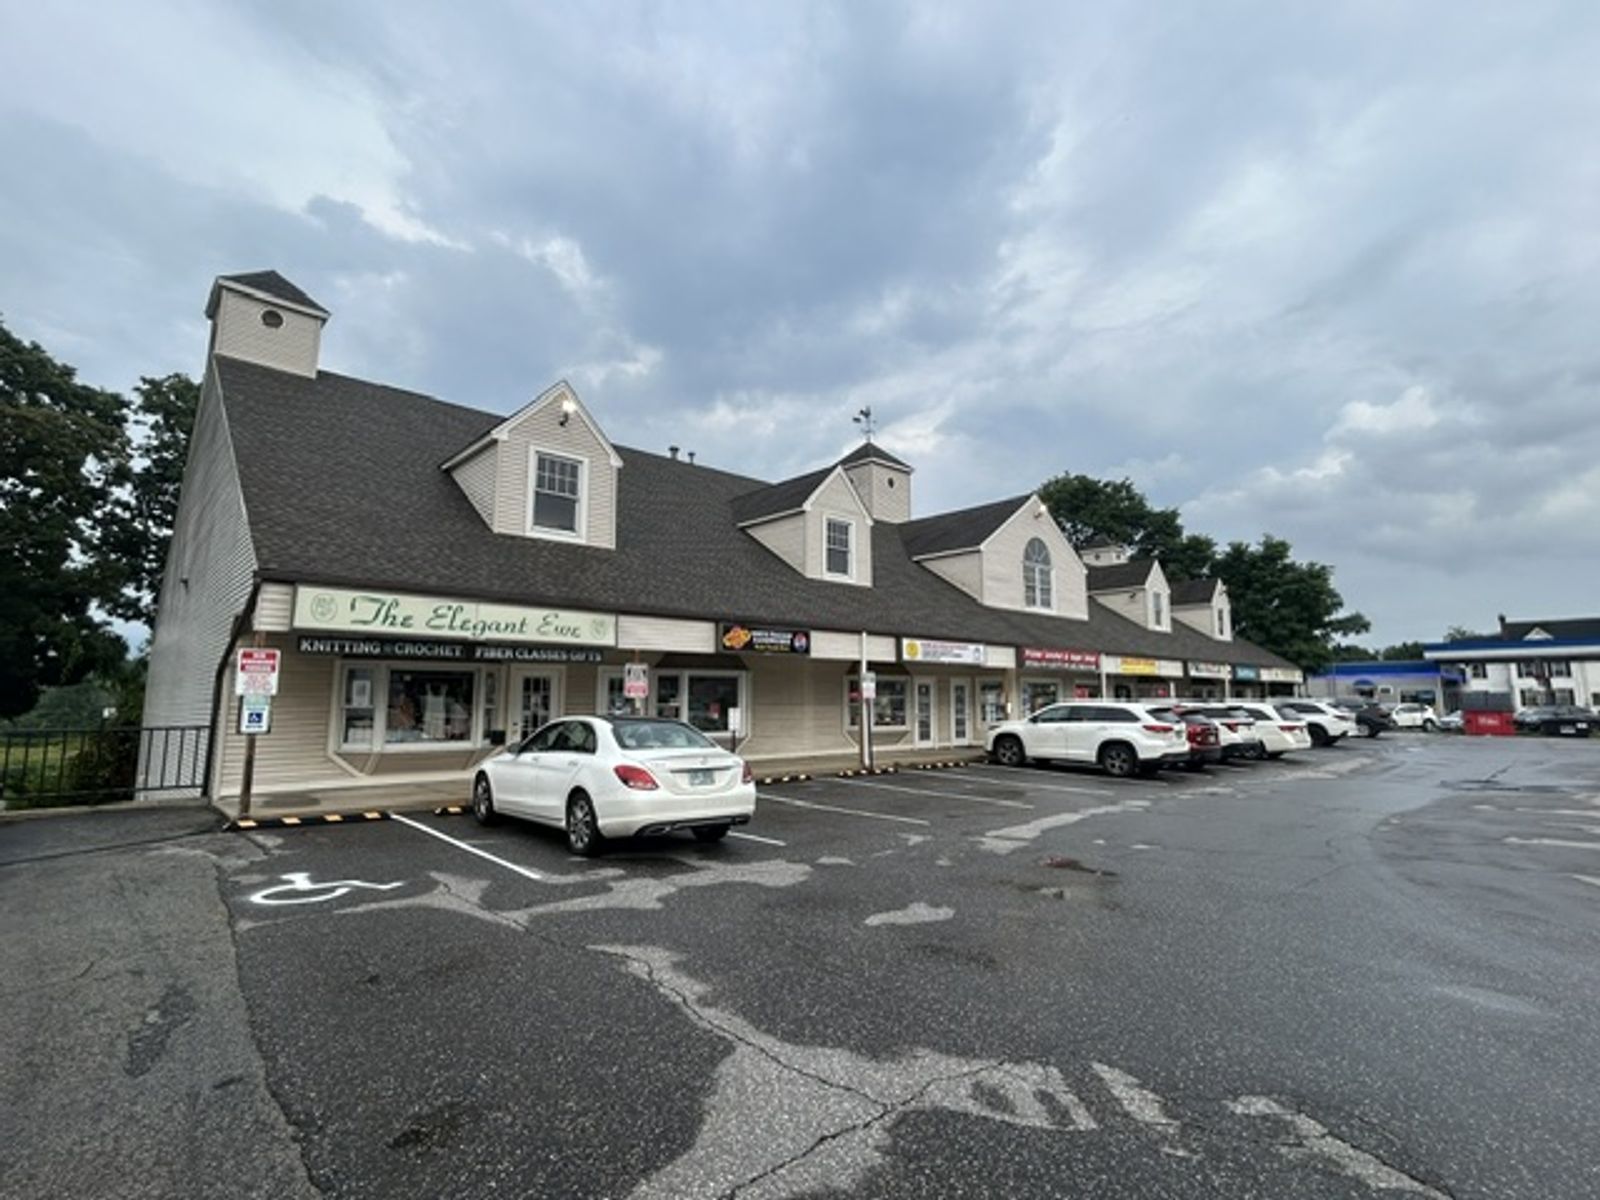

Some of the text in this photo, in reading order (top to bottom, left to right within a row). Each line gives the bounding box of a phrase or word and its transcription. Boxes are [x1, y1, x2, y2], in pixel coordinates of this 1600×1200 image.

[350, 595, 581, 639] The Elegant Ewe
[300, 639, 382, 655] KNITTING
[394, 642, 464, 657] CROCHET
[474, 645, 514, 659] FIBER
[515, 647, 567, 660] CLASSES
